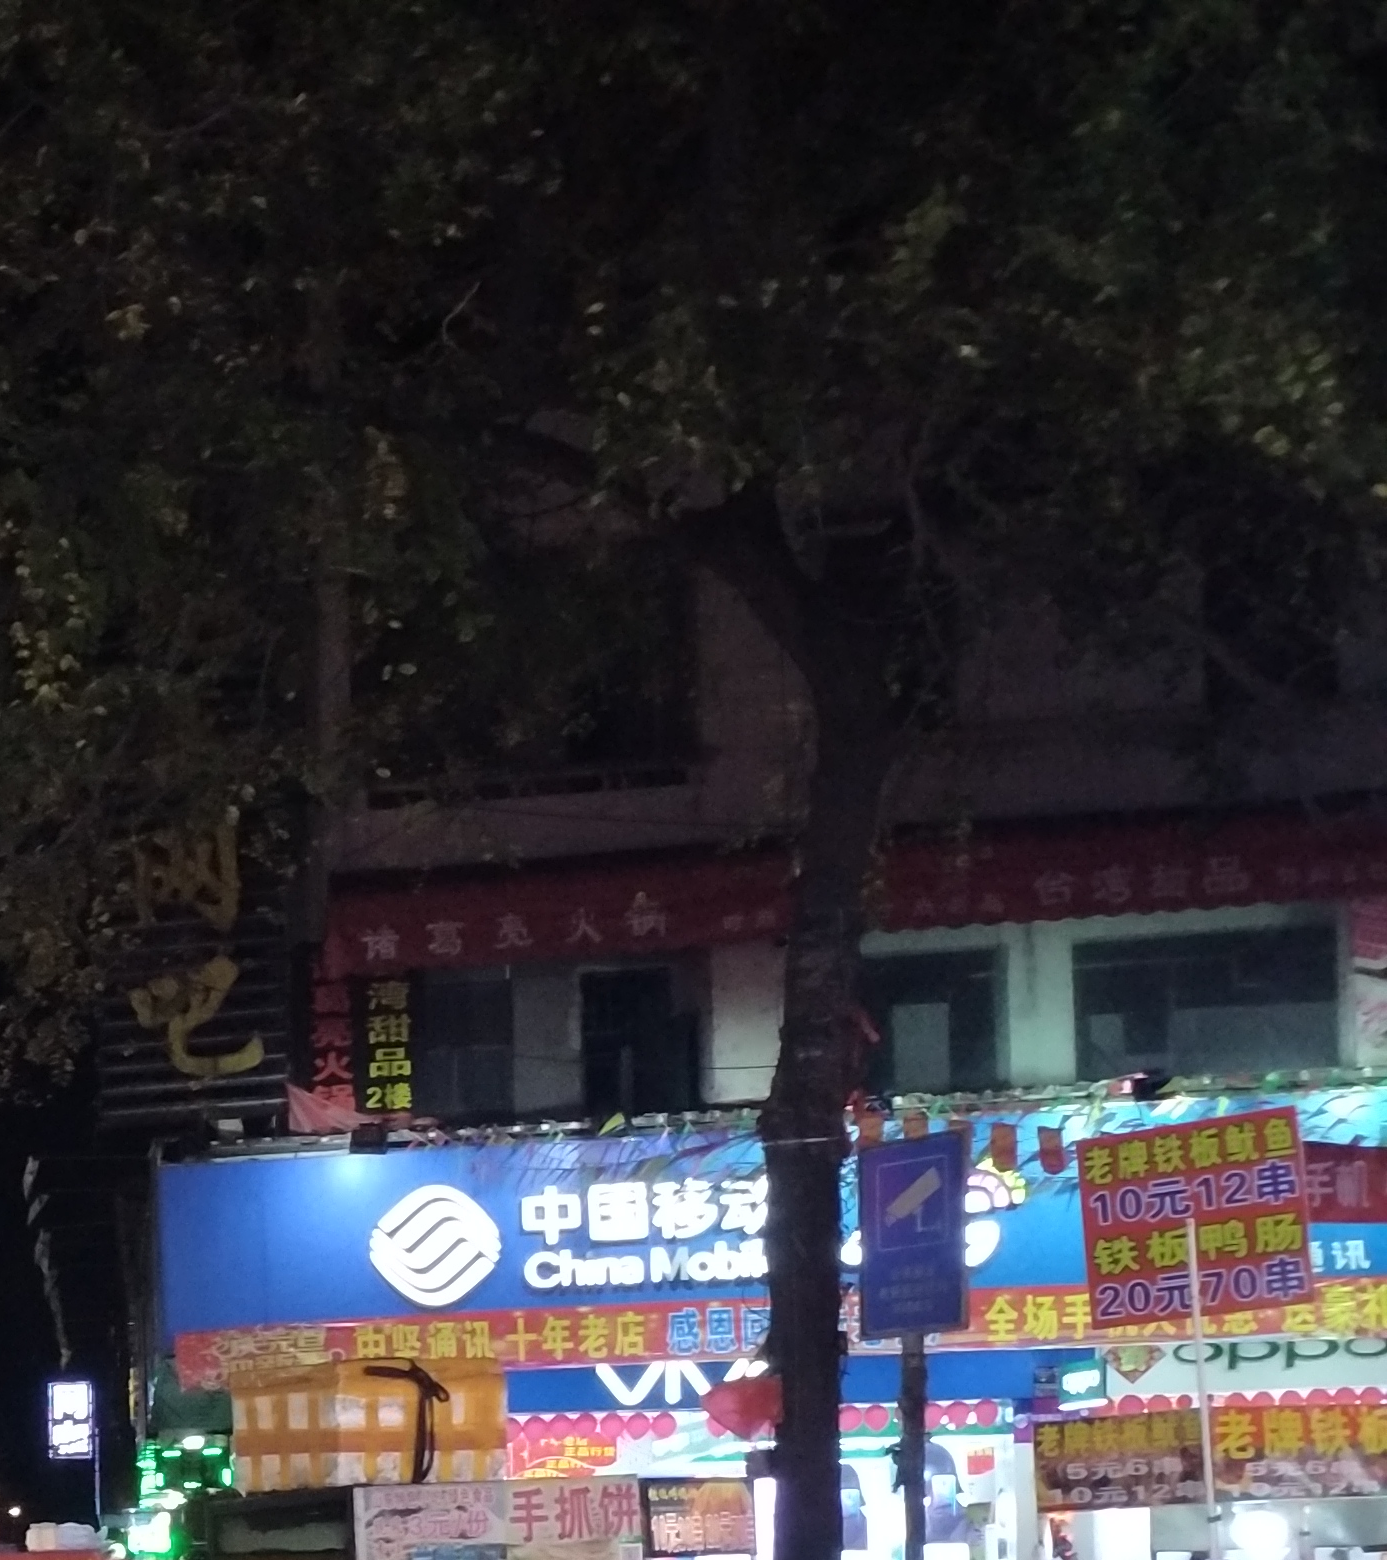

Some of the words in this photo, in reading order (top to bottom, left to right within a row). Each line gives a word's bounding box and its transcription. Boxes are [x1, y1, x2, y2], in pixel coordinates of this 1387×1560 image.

[1084, 1117, 1298, 1184] 老牌铁板鱿鱼
[1090, 1160, 1298, 1226] 10元12串
[524, 1248, 644, 1290] China
[1093, 1213, 1304, 1276] 铁板鸭肠
[1096, 1257, 1306, 1321] 20元70串
[505, 1312, 645, 1361] 十年老店
[509, 1482, 639, 1543] 手抓饼
